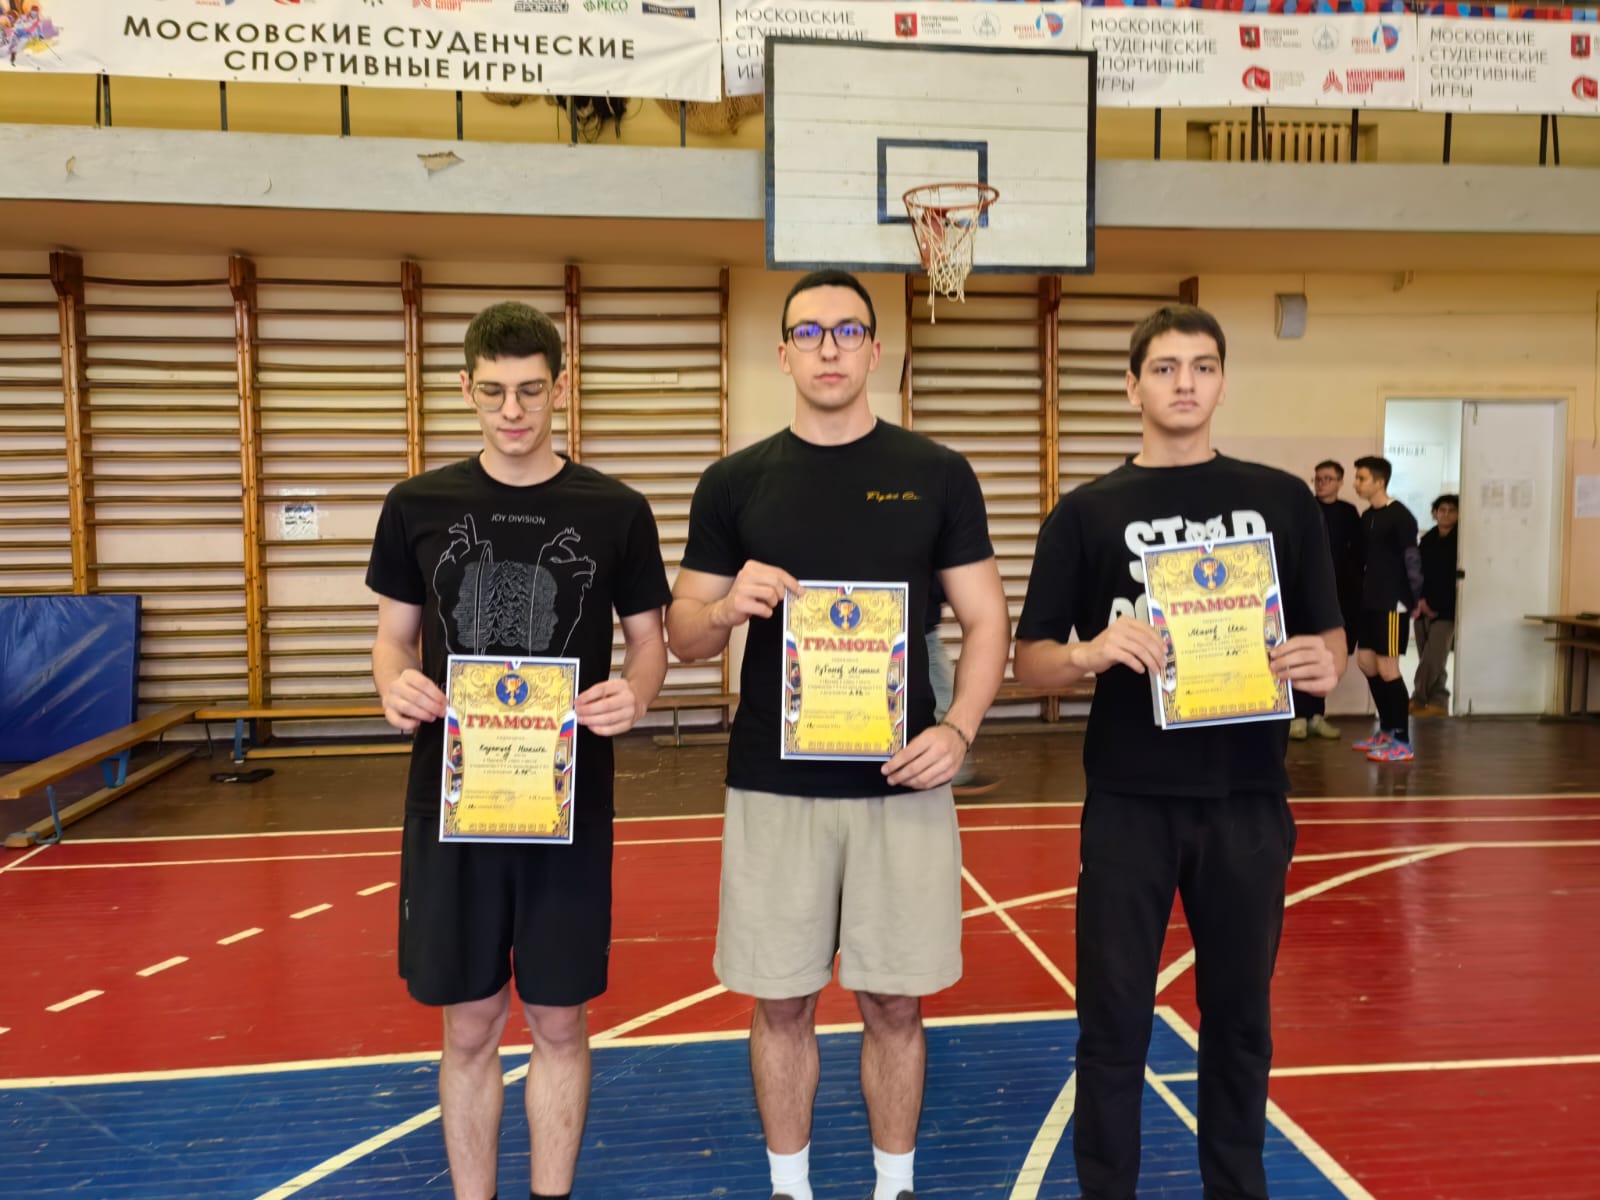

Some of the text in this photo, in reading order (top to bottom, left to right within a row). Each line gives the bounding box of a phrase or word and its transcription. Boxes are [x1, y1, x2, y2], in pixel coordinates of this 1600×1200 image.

[736, 8, 855, 25] МОСКОВСКИЕ
[1091, 18, 1204, 35] МОСКОВСКИЕ
[123, 15, 634, 60] МОСКОВСКИЕ СТУДЕНЧЕСКИЕ
[1430, 27, 1535, 46] МОСКОВСКИЕ
[1092, 37, 1217, 55] СТУДЕНЧЕСКИЕ
[1429, 46, 1548, 65] СТУДЕНЧЕСКИЕ
[224, 50, 543, 83] СПОРТИВНЫЕ ИГРЫ
[738, 64, 765, 80] ИГ
[1099, 56, 1205, 74] ПОРТИВНЫЕ
[1430, 65, 1537, 82] СПОРТИВНЫЕ
[1430, 82, 1473, 98] ИГРЫ
[491, 513, 546, 525] JOY DIVISION
[1170, 593, 1262, 617] ГРАМОТА
[803, 636, 889, 653] ГРАМОТА
[465, 713, 558, 730] ГРАМОТА
